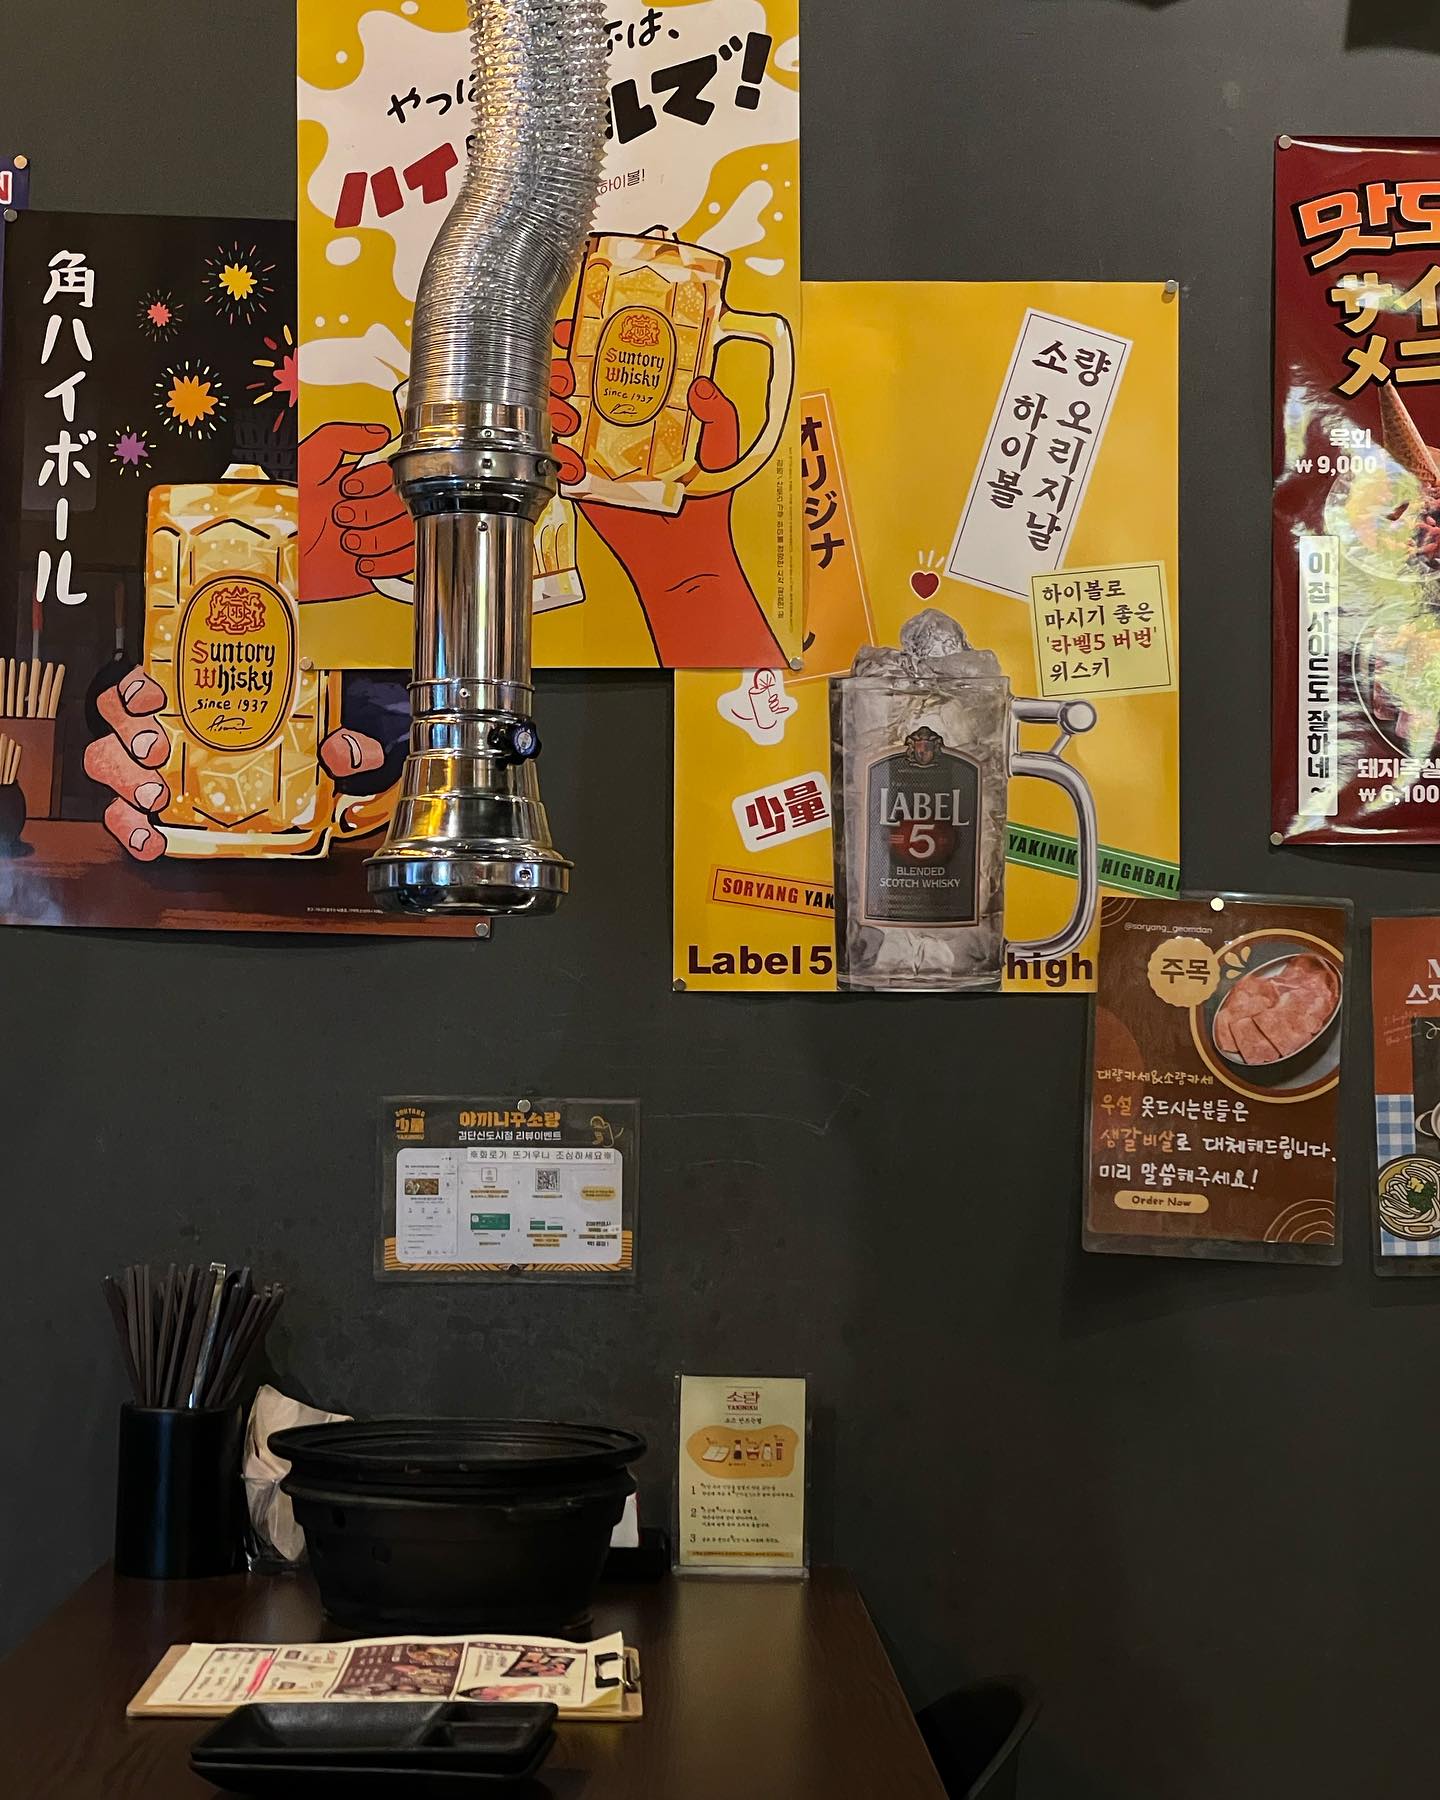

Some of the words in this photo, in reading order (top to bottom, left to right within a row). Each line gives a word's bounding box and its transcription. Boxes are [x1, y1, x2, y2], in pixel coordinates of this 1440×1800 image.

[604, 347, 665, 372] Suntory
[1031, 339, 1112, 387] 소량
[605, 366, 660, 390] Whisky
[631, 392, 654, 404] 1937
[36, 249, 98, 605] 角ハイボール
[1329, 428, 1372, 448] 육회
[986, 392, 1049, 510] 하이볼
[1026, 400, 1093, 552] 오리지날
[1317, 455, 1377, 477] 9,000
[1042, 579, 1126, 604] 하이볼로
[1044, 605, 1105, 631] 마시기
[1112, 602, 1155, 625] 좋은
[190, 639, 276, 668] Suntory
[193, 664, 273, 697] Whisky
[1049, 657, 1110, 682] 위스키
[237, 699, 268, 713] 1937
[745, 780, 830, 841] 少量
[879, 787, 970, 827] LABEL
[908, 824, 936, 859] 5
[879, 877, 919, 888] SCOTCH
[922, 878, 961, 889] WHISKY
[896, 866, 945, 876] BLENDED
[722, 877, 799, 904] SORYANG
[688, 945, 801, 975] Label
[1007, 951, 1093, 987] high
[1160, 958, 1211, 985] 주목
[1099, 1093, 1133, 1117] 우설
[1099, 1162, 1132, 1181] 미리
[1131, 1195, 1165, 1206] Order
[1167, 1197, 1192, 1207] Now
